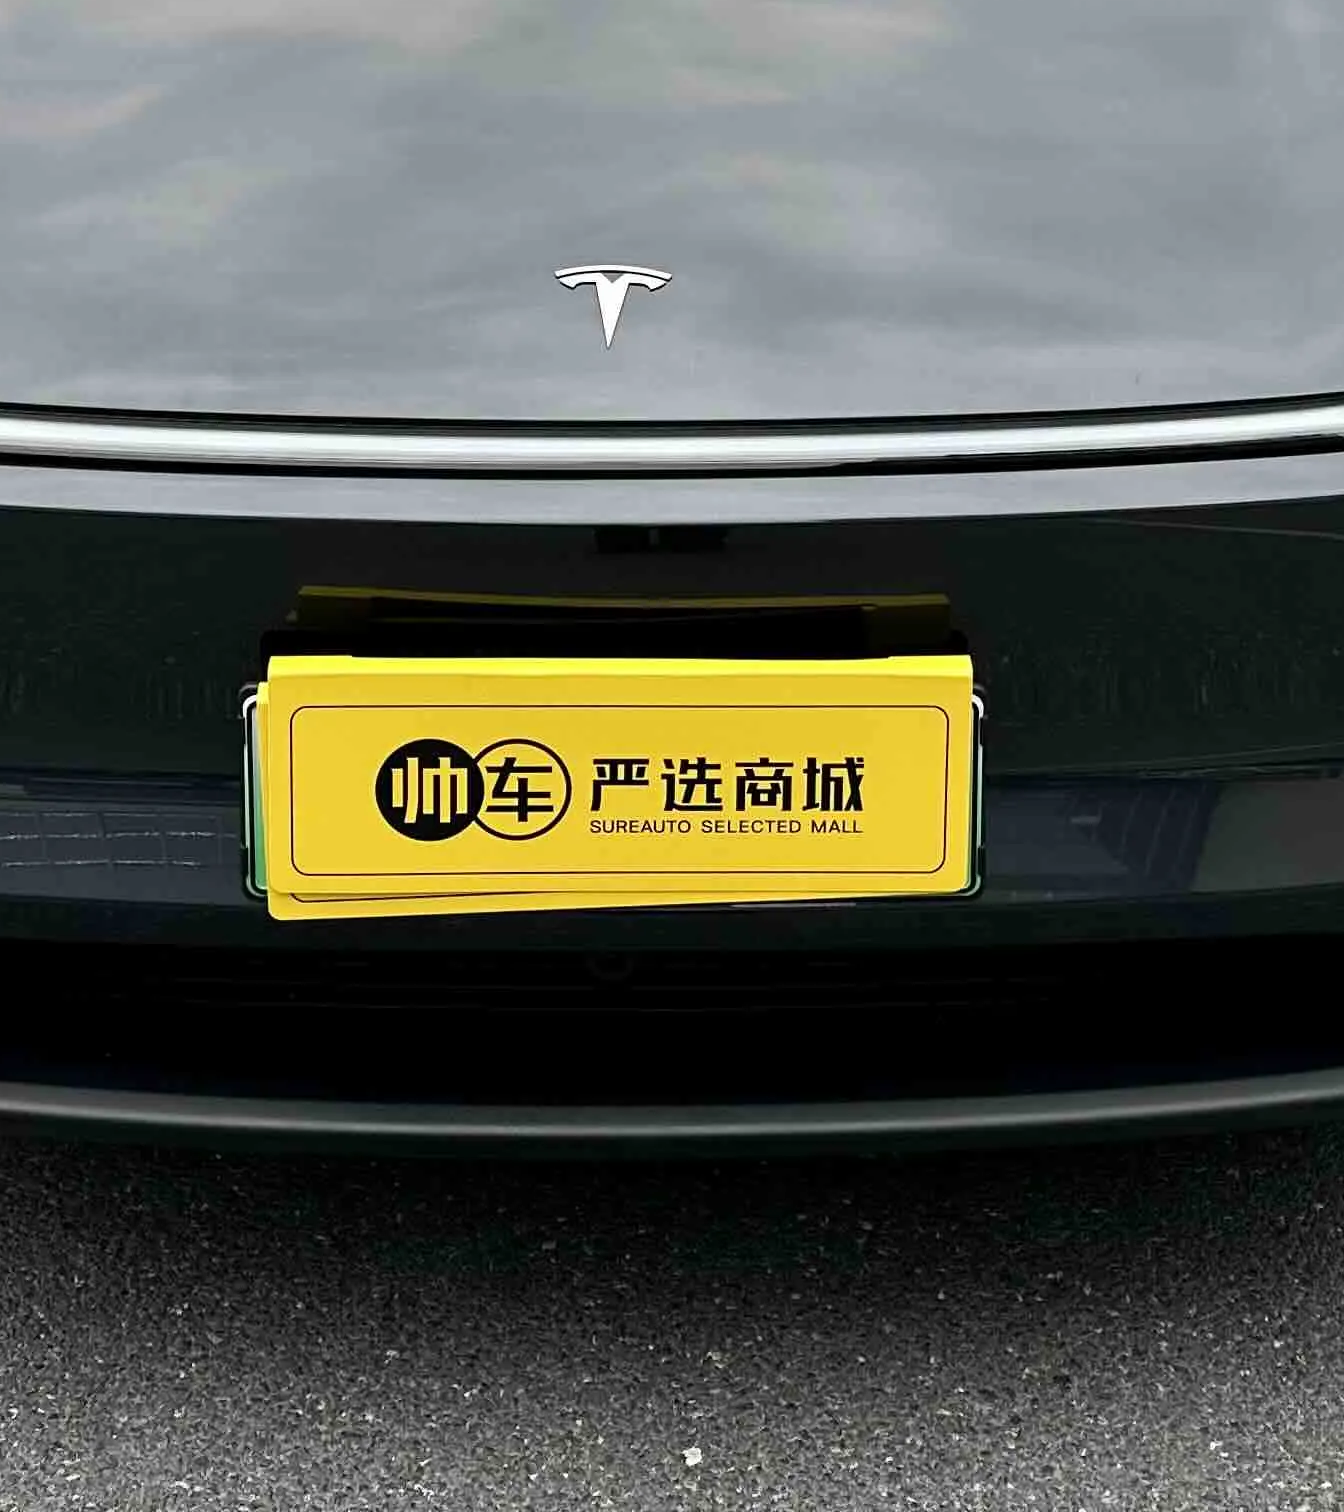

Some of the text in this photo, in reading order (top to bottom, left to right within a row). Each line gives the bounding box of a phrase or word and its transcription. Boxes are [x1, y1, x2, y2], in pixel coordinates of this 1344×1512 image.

[590, 756, 865, 812] 严选商城
[590, 819, 864, 834] SUREAUTO SELECTED MALL
